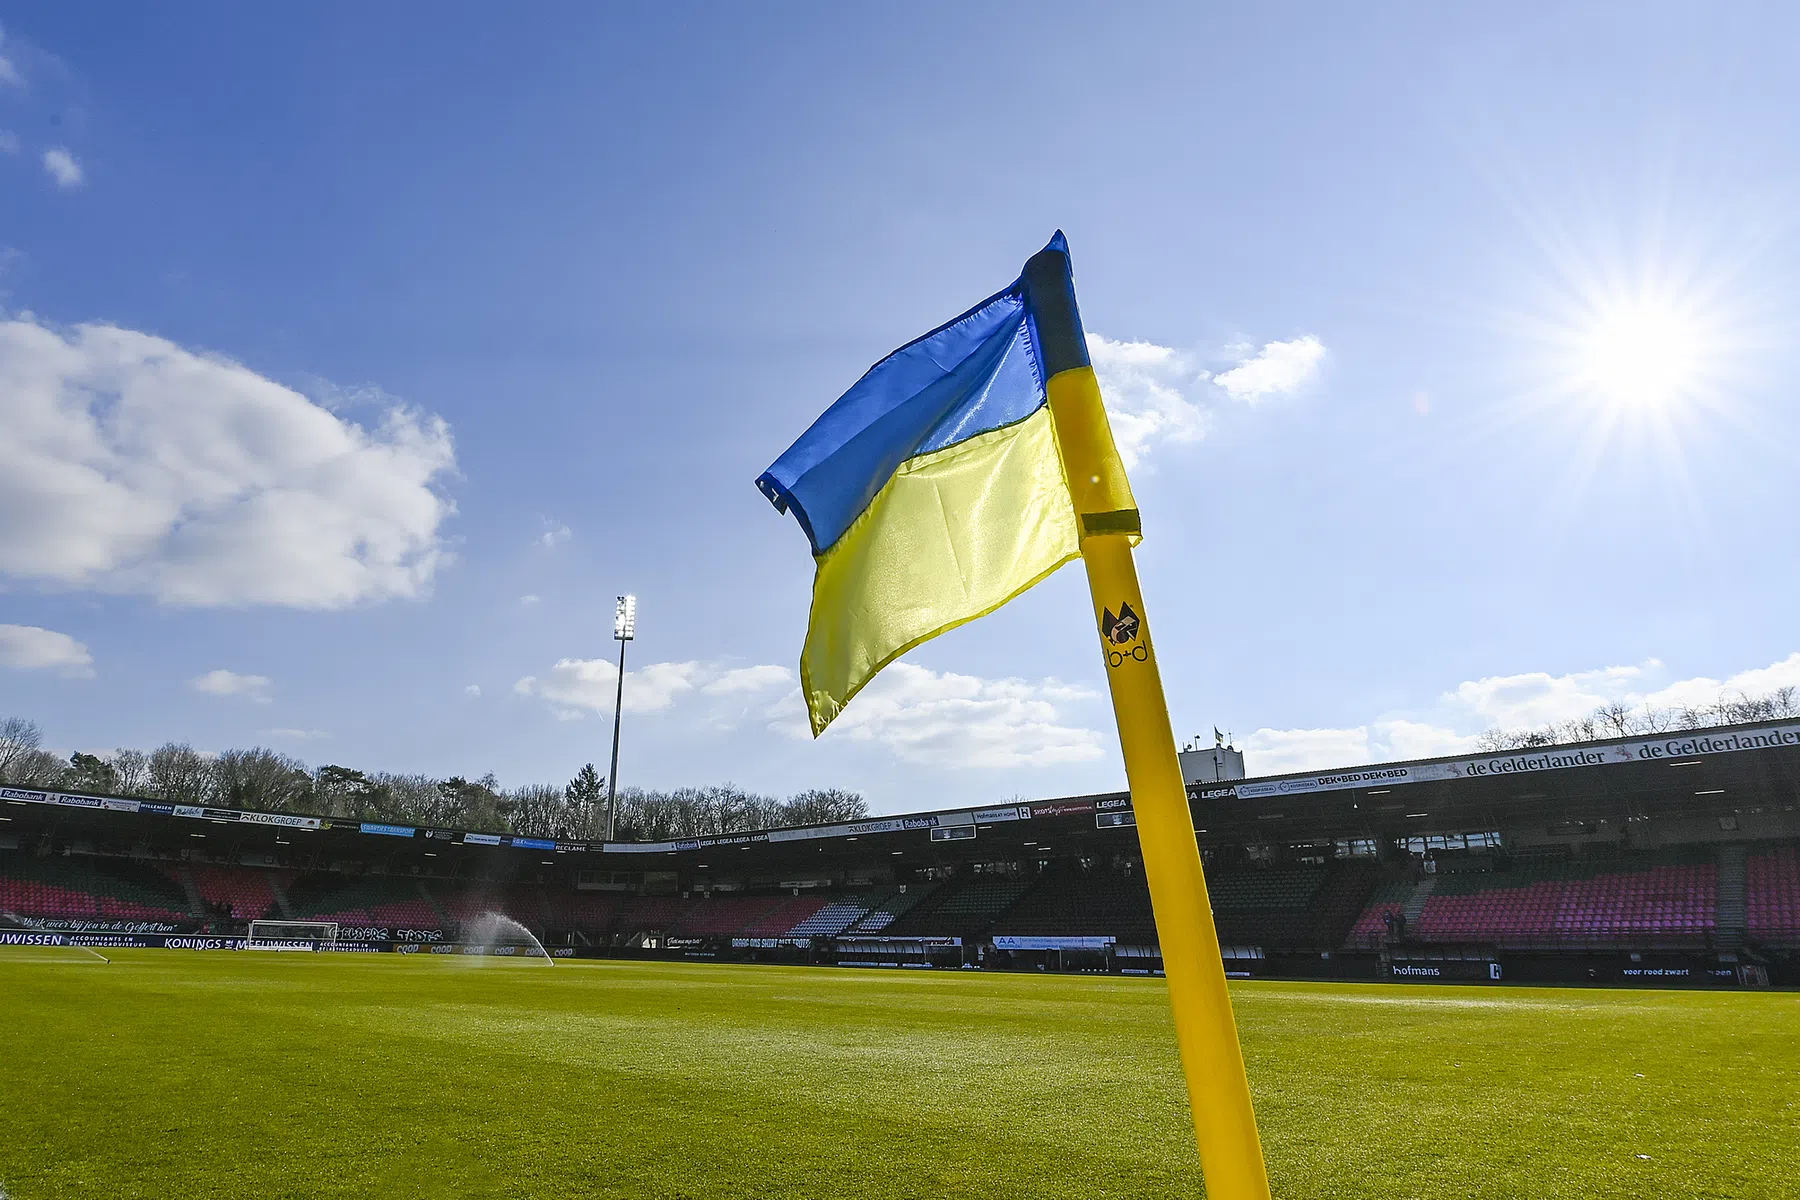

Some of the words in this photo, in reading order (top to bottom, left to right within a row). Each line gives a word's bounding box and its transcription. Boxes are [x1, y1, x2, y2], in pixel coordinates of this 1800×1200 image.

[1107, 640, 1148, 667] b+d
[1639, 745, 1662, 759] de
[1666, 730, 1800, 756] Gelderlander
[1466, 762, 1486, 776] de
[1489, 751, 1605, 773] Gelderlander
[3, 790, 43, 801] Rabobank
[1201, 788, 1236, 799] LEGEA
[60, 796, 100, 807] Rabobank
[141, 803, 173, 811] WILLEMSEN
[1096, 799, 1127, 809] LEGEA
[250, 813, 302, 826] KLOKGROEP
[904, 817, 937, 828] Rabobank
[853, 821, 892, 833] KLOKGROEP
[751, 834, 769, 842] LEGEA
[100, 920, 109, 930] in
[111, 921, 122, 930] de
[329, 927, 390, 940] GELDERS
[397, 929, 444, 941] TROTS
[68, 940, 147, 948] BELASTINGADVISEURS
[164, 938, 222, 949] KONINGS
[761, 938, 778, 948] SHIRT
[1393, 965, 1440, 976] hofmans
[1623, 968, 1641, 976] voor
[1643, 967, 1662, 976] rood
[1664, 968, 1689, 976] zwart
